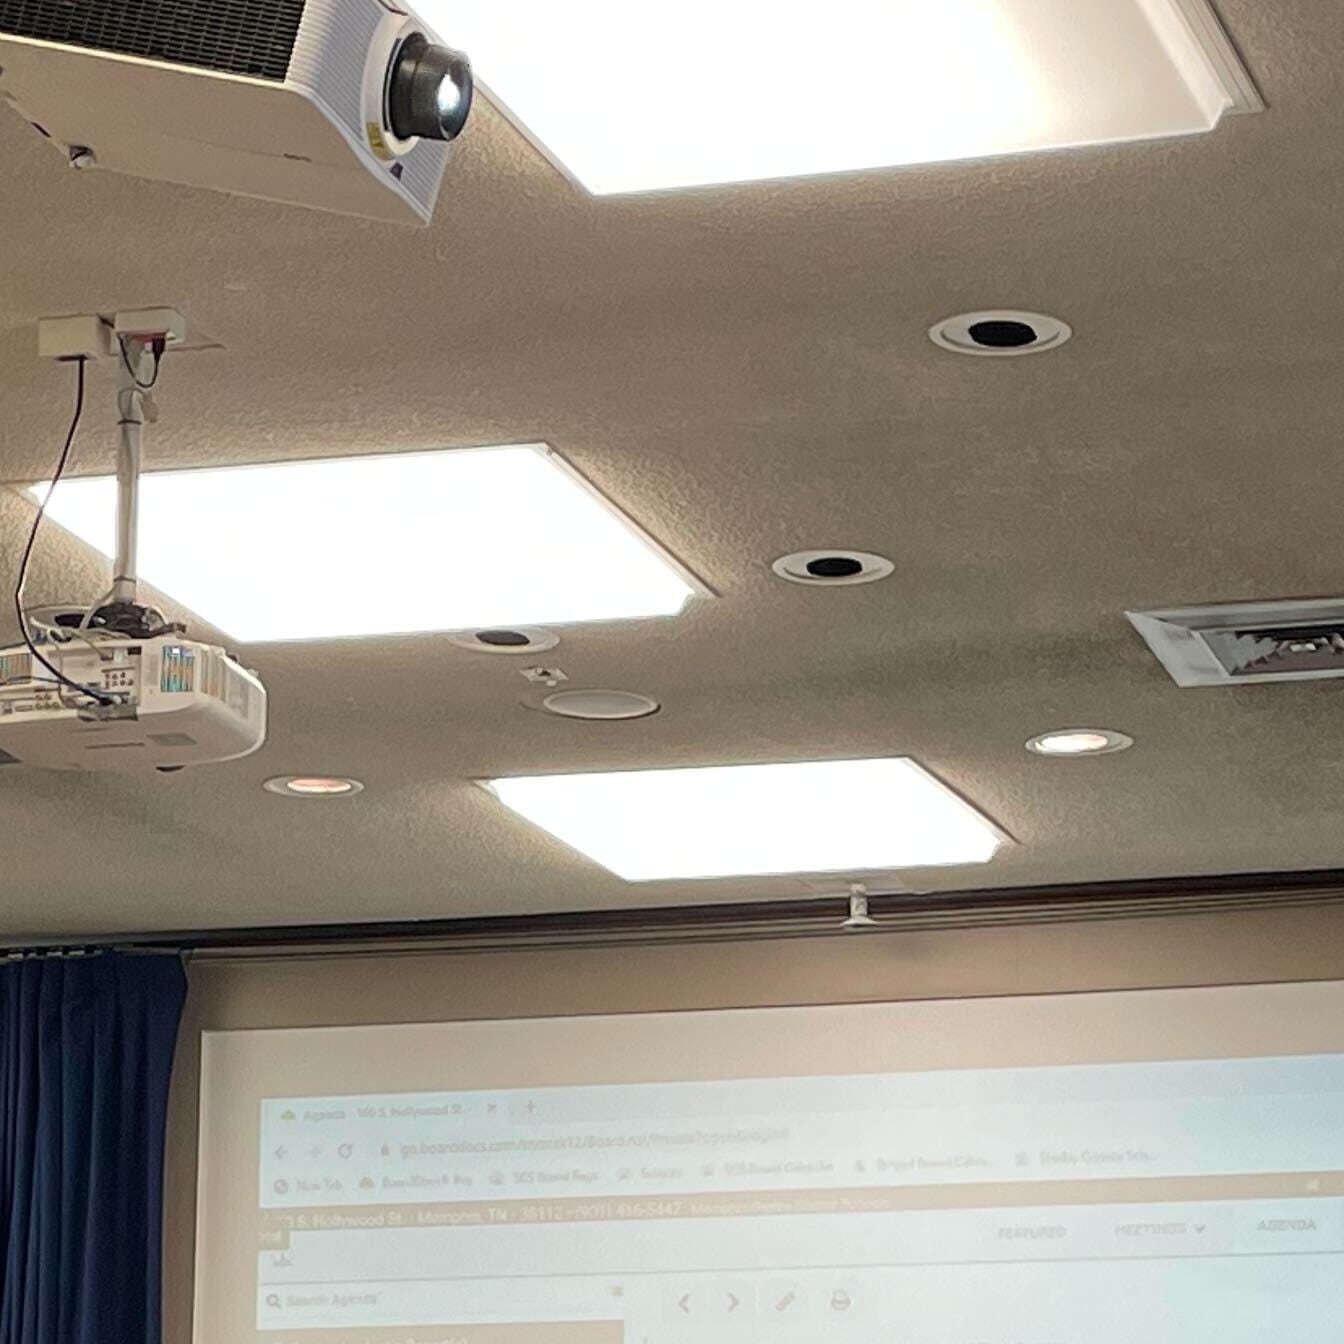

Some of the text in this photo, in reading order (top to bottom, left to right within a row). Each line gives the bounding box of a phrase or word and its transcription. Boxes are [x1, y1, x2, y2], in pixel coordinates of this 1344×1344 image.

[311, 1212, 384, 1228] Hollywood
[486, 1207, 507, 1222] TN
[615, 1201, 682, 1217] 416-5447
[996, 1225, 1068, 1239] FEATURED
